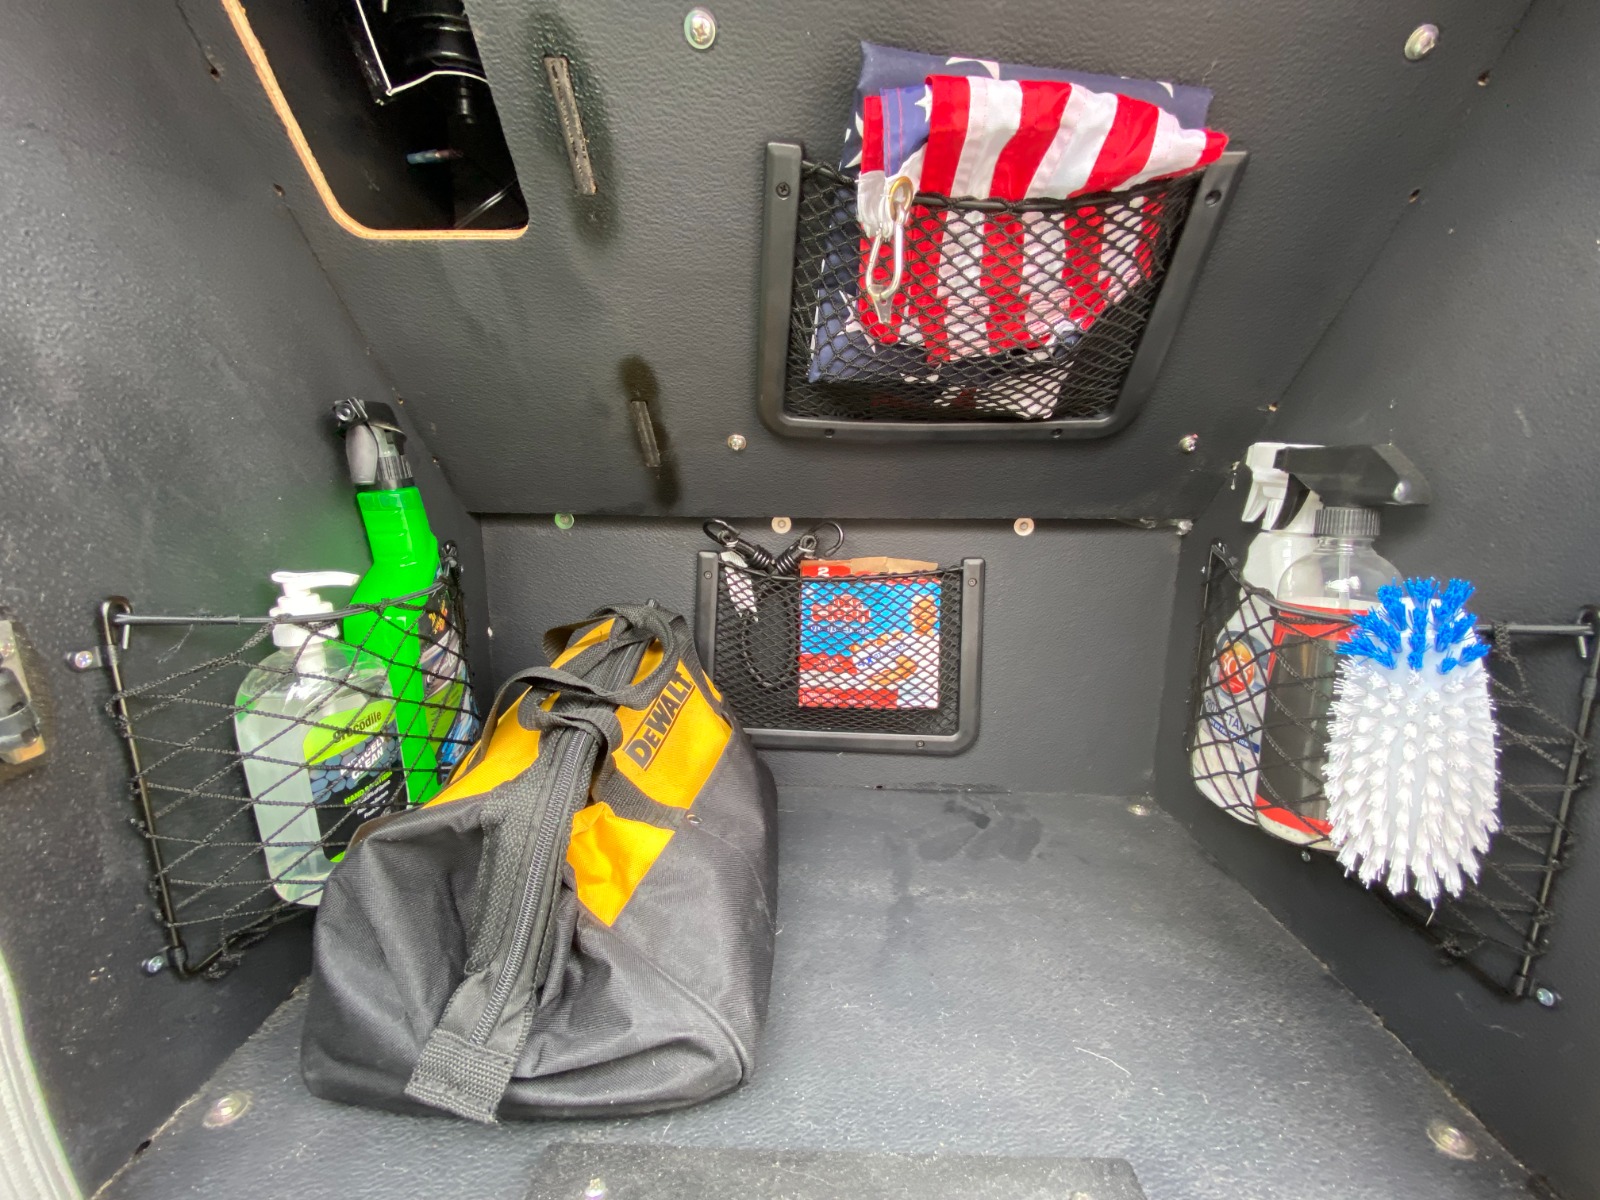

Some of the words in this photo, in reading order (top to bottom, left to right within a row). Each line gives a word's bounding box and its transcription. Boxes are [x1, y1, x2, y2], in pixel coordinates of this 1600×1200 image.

[817, 566, 830, 577] 2
[624, 672, 694, 769] DEWALT
[344, 789, 365, 805] HAND
